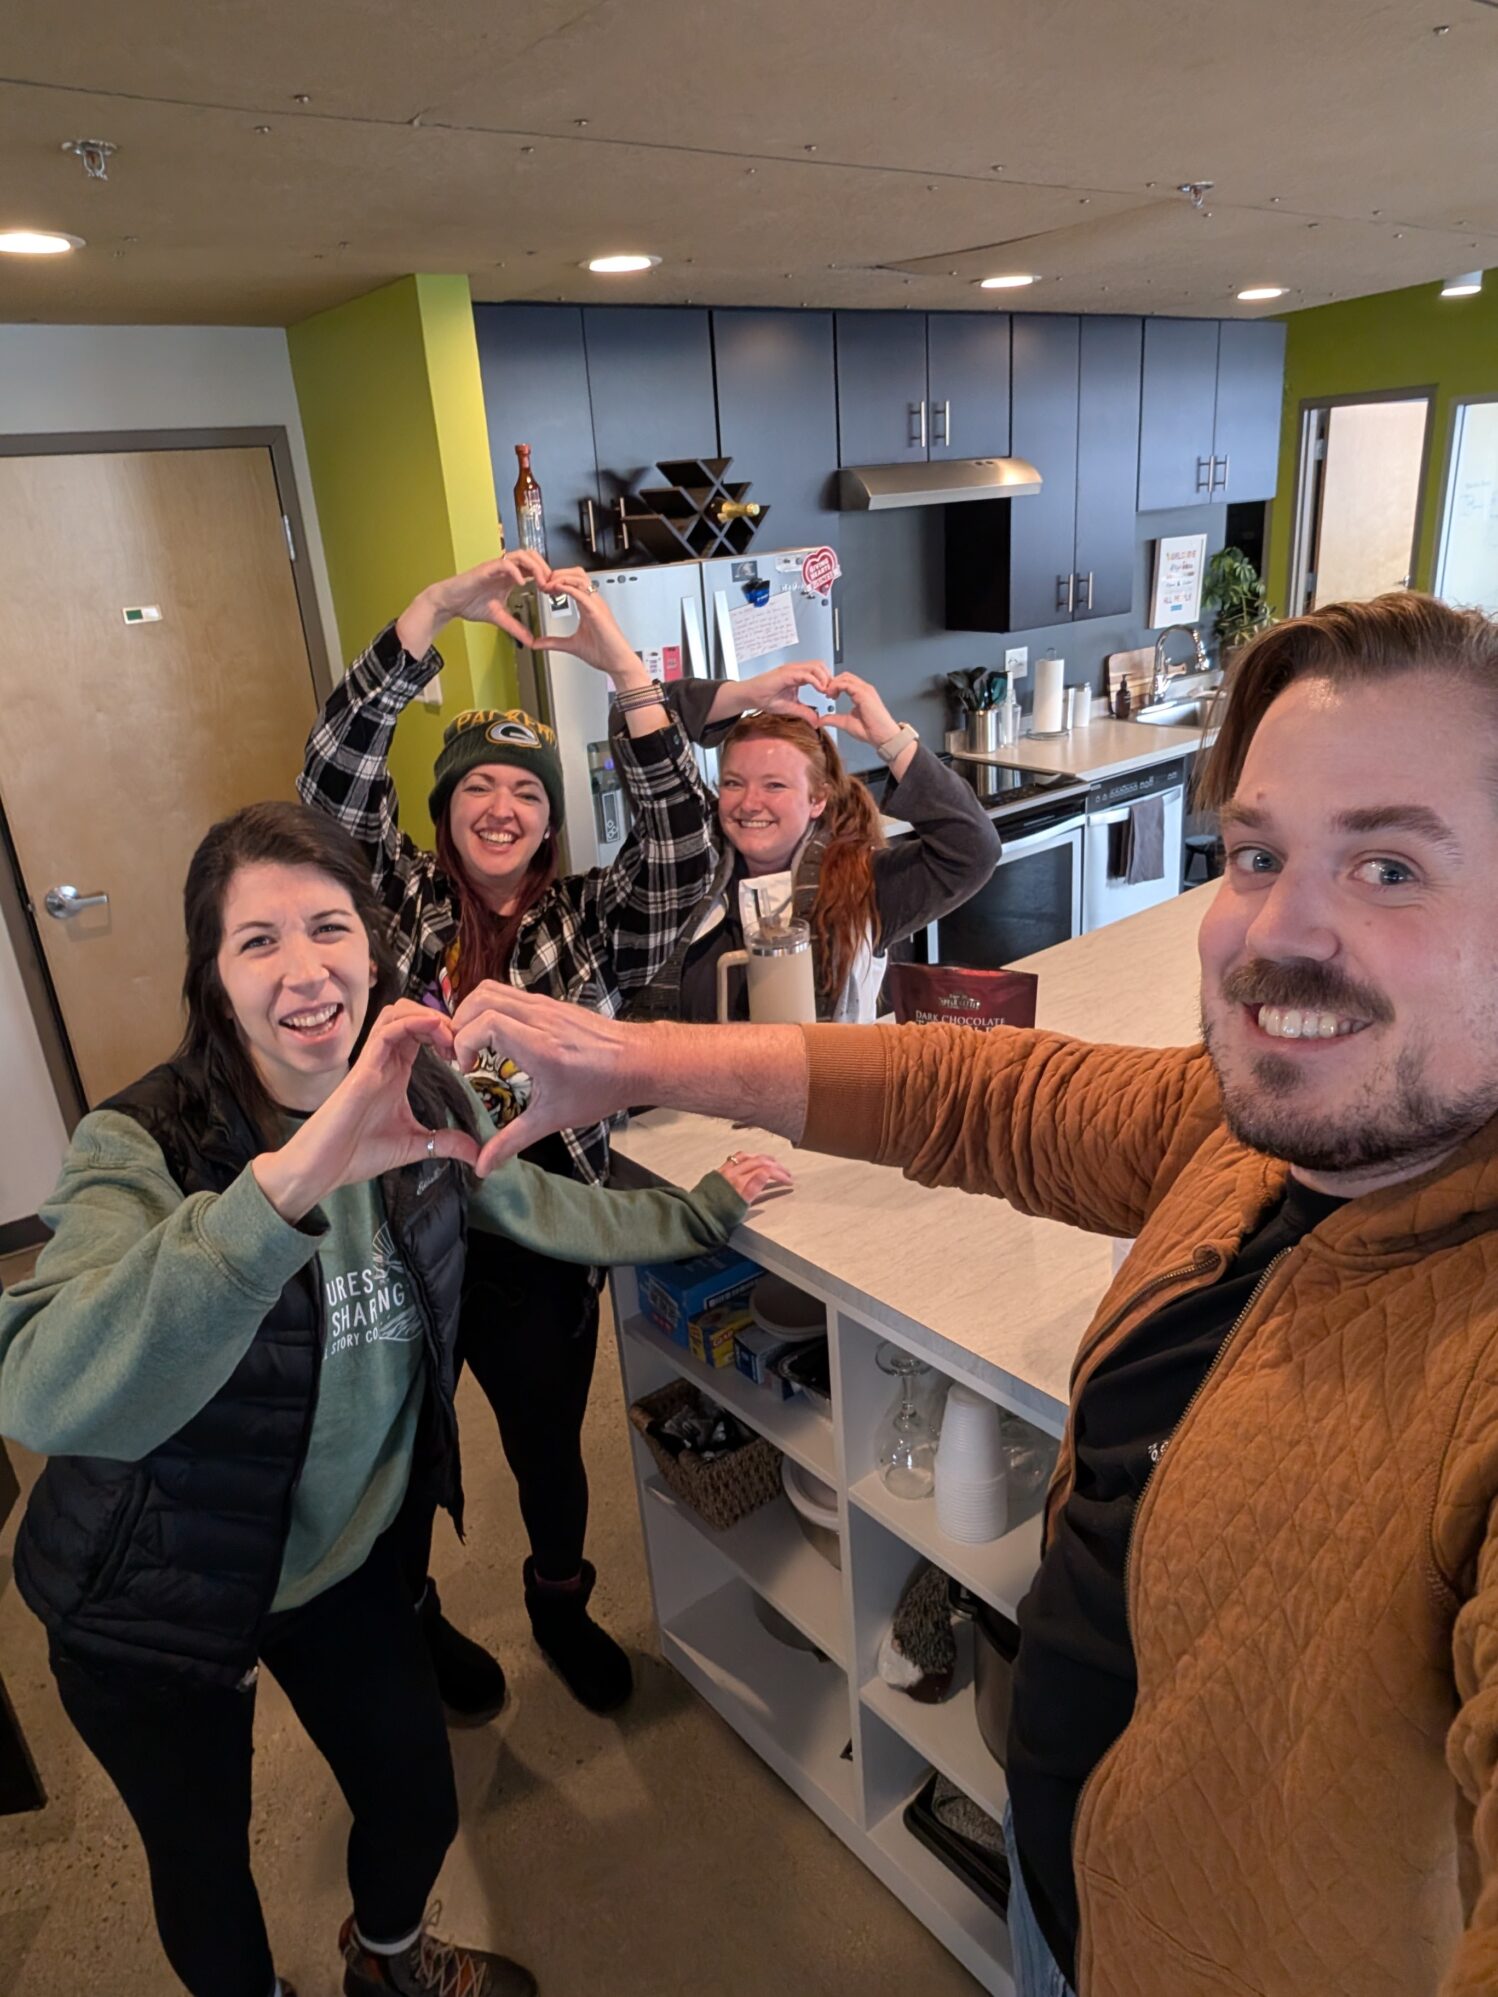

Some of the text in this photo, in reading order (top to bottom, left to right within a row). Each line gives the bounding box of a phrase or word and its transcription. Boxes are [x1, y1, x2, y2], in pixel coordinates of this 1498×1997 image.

[916, 1010, 938, 1021] DARK
[942, 1014, 1005, 1026] CHOCOLATE
[332, 1282, 405, 1337] SHARNG
[331, 1333, 360, 1355] STORY
